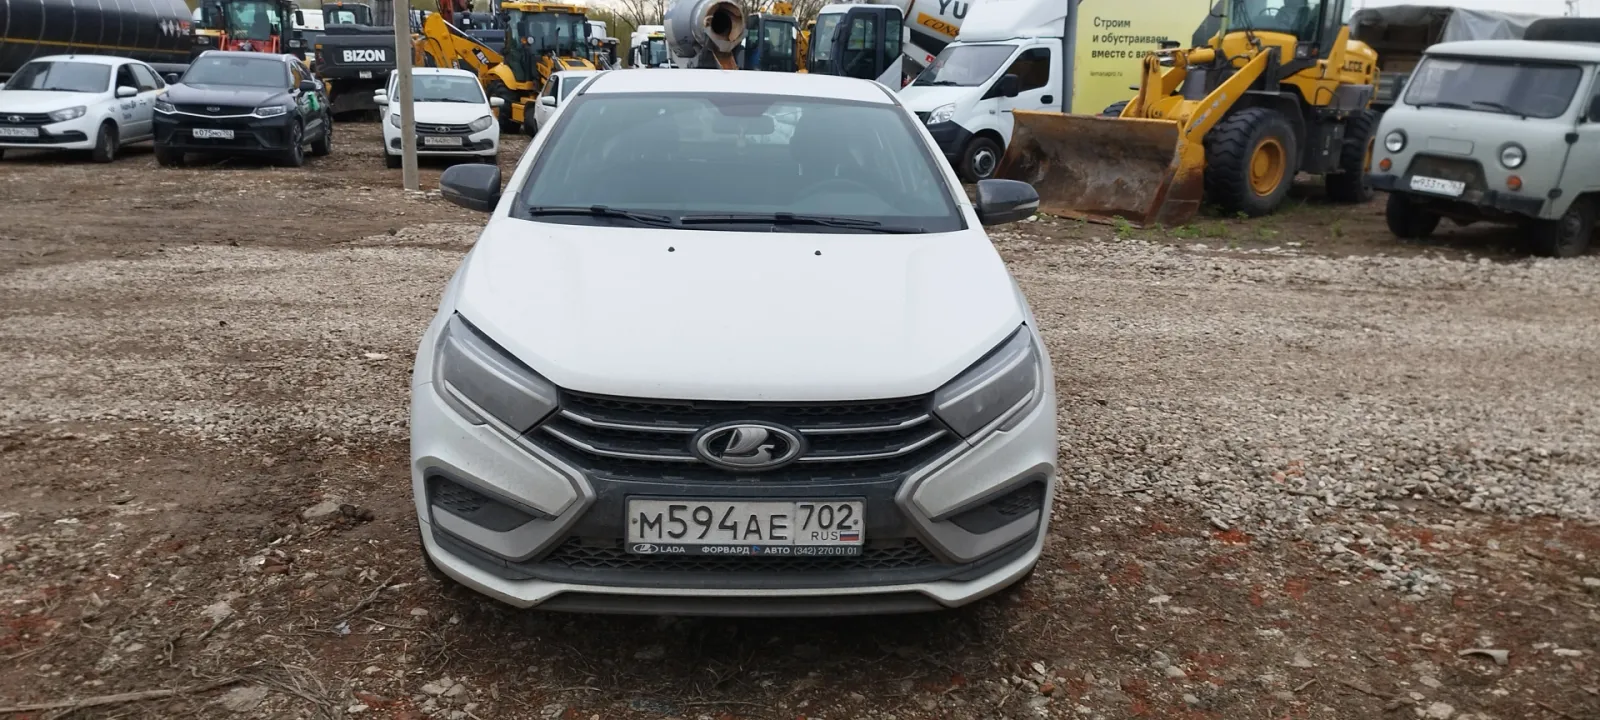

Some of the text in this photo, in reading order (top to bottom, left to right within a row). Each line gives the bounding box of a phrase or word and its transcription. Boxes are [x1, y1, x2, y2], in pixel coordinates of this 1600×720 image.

[1094, 16, 1131, 30] Строим
[1092, 35, 1099, 43] и
[343, 49, 386, 62] BIZON
[1091, 50, 1126, 58] вместе
[639, 504, 852, 541] М594АЕ 702
[811, 531, 838, 541] RUS
[701, 546, 750, 555] ФОРВАРД
[794, 547, 816, 556] (342)
